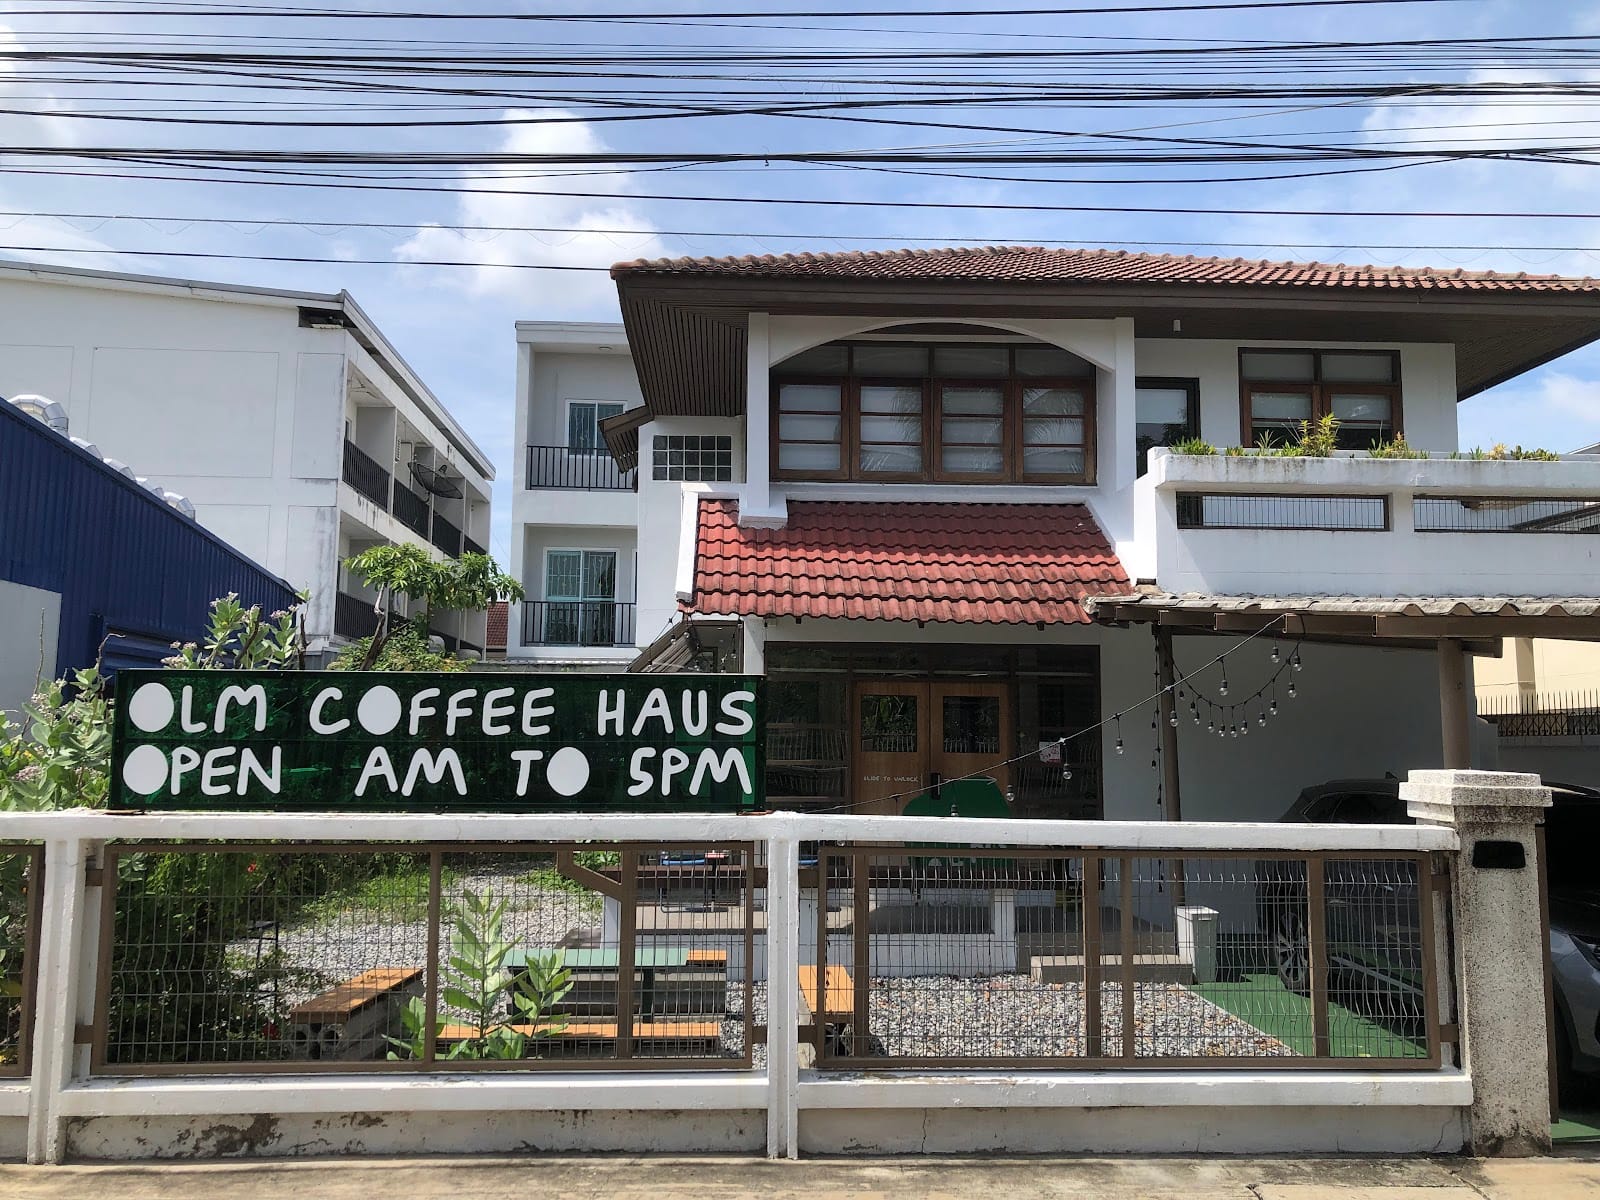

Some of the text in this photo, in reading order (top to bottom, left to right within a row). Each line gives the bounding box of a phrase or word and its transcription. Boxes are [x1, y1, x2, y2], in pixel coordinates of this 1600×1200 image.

[128, 682, 756, 736] OLM COFFEE HAUS
[122, 744, 753, 797] OPEN AM TO 5PM
